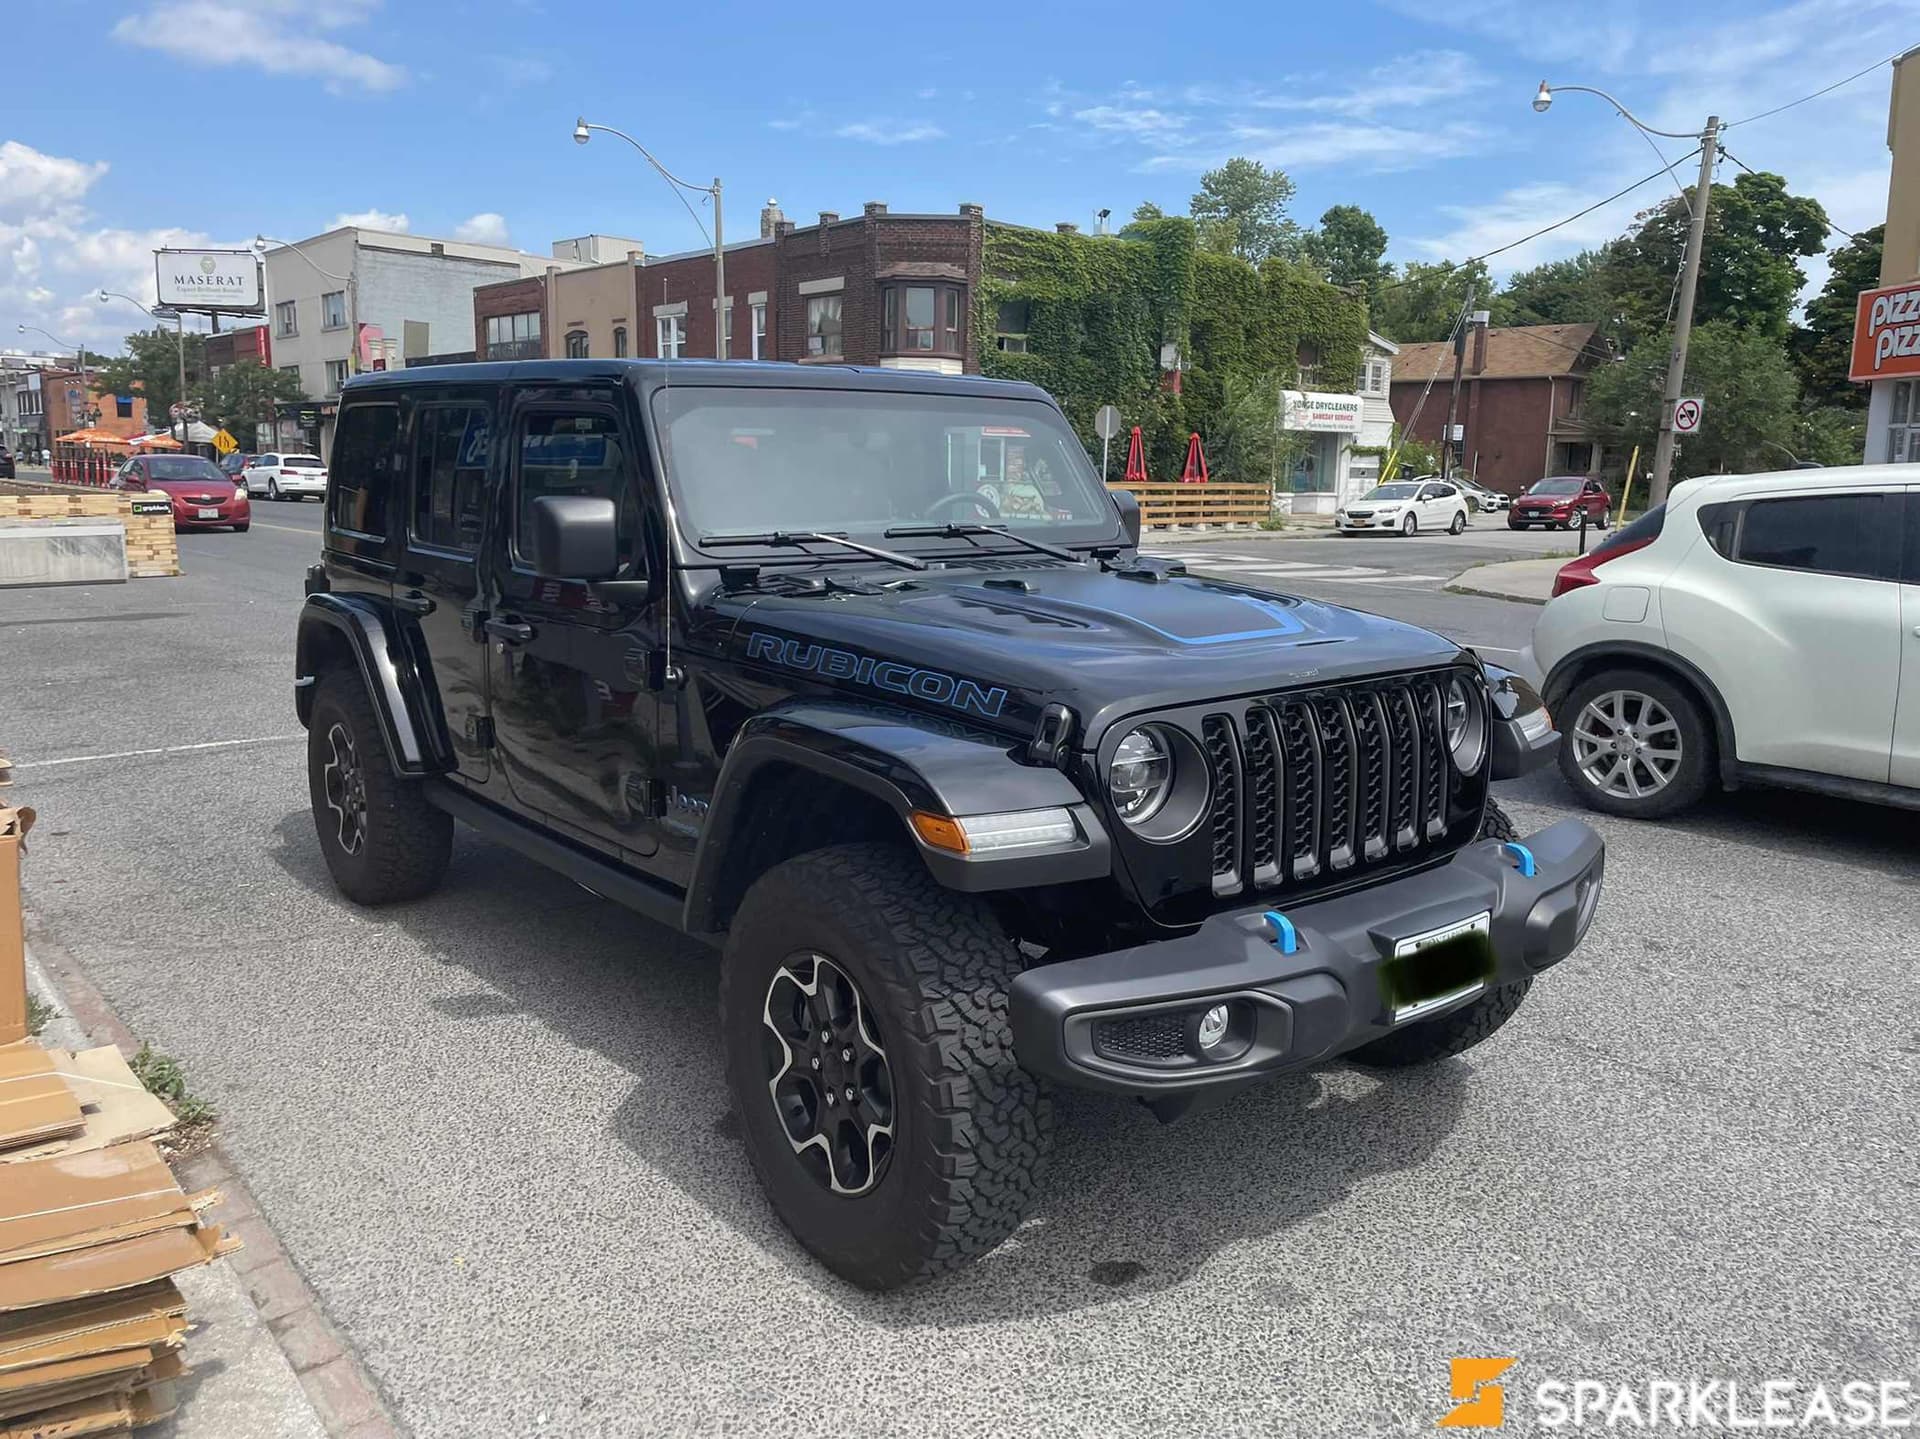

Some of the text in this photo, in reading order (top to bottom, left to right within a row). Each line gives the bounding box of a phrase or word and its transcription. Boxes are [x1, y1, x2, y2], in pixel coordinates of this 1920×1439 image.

[174, 274, 244, 286] MASERAT
[1868, 290, 1920, 337] PIZZ
[1315, 401, 1358, 412] DRYCLEANERS
[747, 632, 1008, 717] RUBICON
